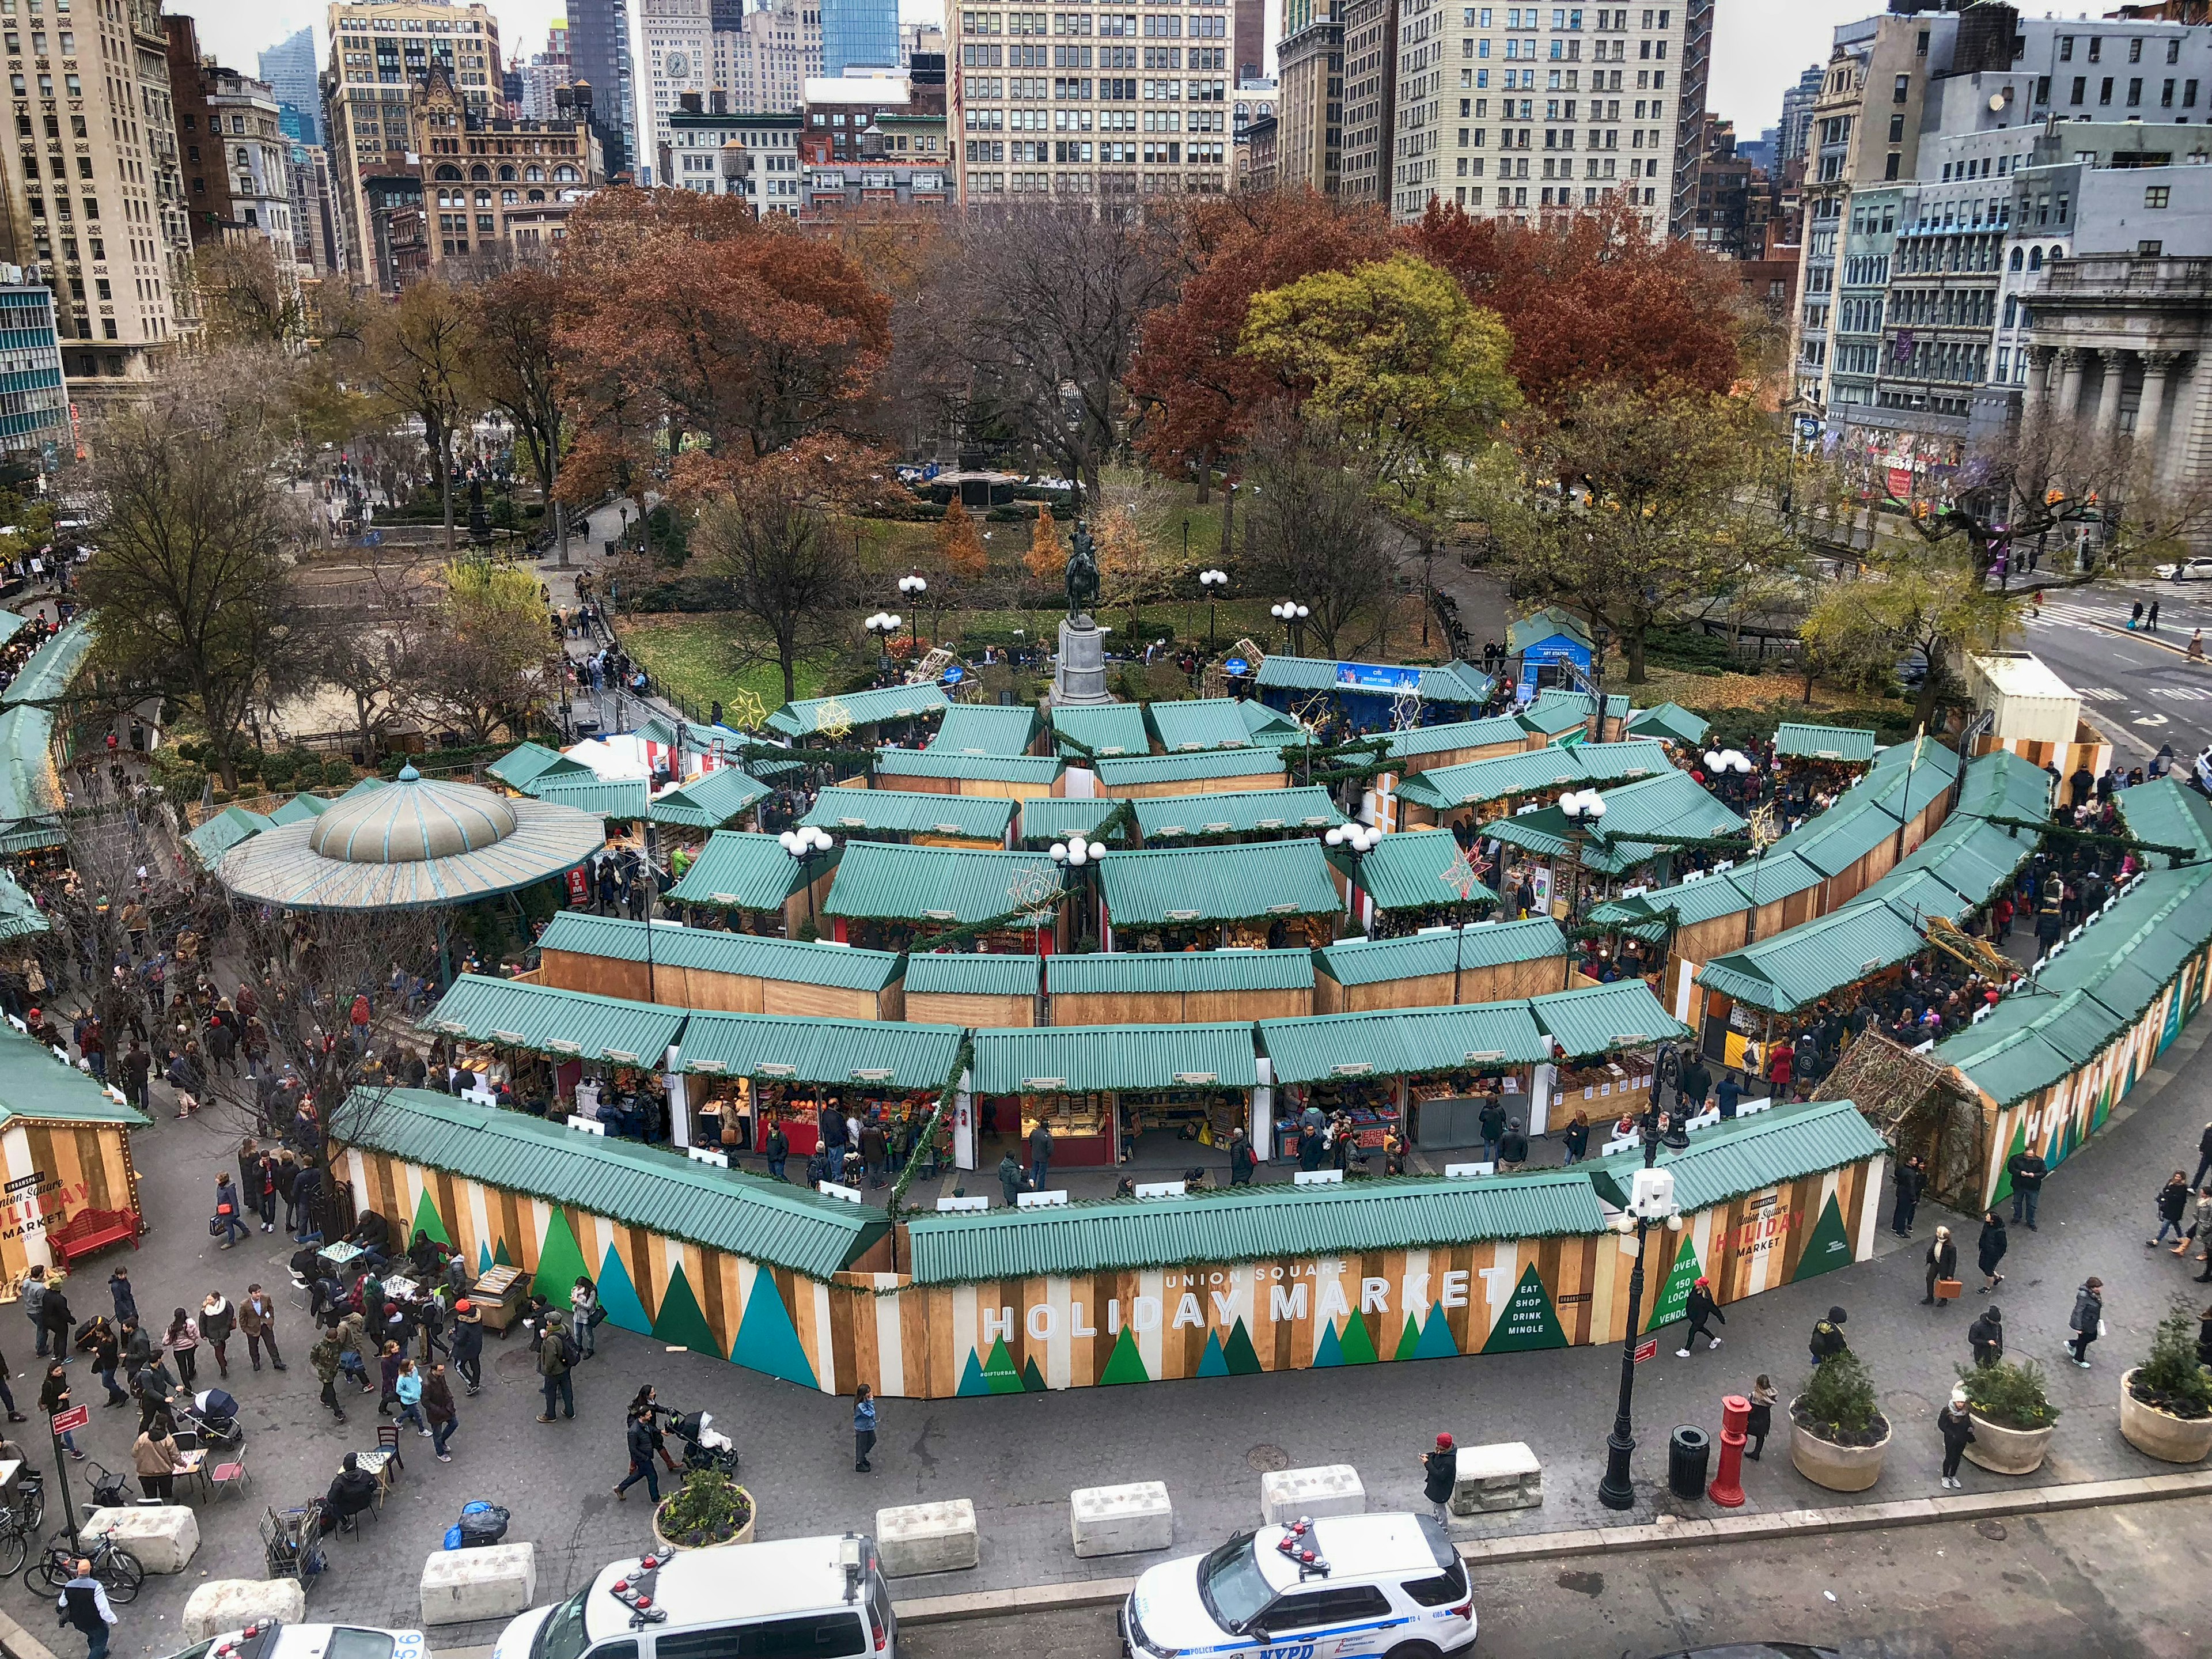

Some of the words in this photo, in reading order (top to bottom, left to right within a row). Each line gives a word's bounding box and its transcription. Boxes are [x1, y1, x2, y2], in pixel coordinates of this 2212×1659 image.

[572, 871, 583, 893] ATM
[1362, 1128, 1388, 1137] ERBA
[0, 1192, 23, 1208] nion
[25, 1179, 65, 1200] Square
[0, 1180, 89, 1228] LIDAY
[1751, 1196, 1777, 1209] URBANSPACE
[1736, 1212, 1760, 1227] Union
[1760, 1204, 1789, 1220] Square
[2, 1211, 63, 1240] MARKET
[1715, 1211, 1805, 1253] HOLIDAY
[1736, 1237, 1780, 1258] MARKET
[1673, 1257, 1697, 1273] OVER
[1165, 1271, 1242, 1289] UNION
[1255, 1260, 1349, 1281] SQUARE
[1521, 1285, 1538, 1294] EAT
[1675, 1277, 1691, 1290] 150
[1516, 1298, 1541, 1308] SHOP
[1668, 1287, 1692, 1304] LOCA
[983, 1289, 1243, 1344] HOLIDAY
[1269, 1267, 1507, 1323] MARKET
[1513, 1312, 1541, 1321] DRINK
[1660, 1308, 1687, 1324] VENDO
[1508, 1325, 1544, 1335] MINGLE
[1190, 1646, 1213, 1655] POLICE
[1259, 1644, 1314, 1659] NYPD
